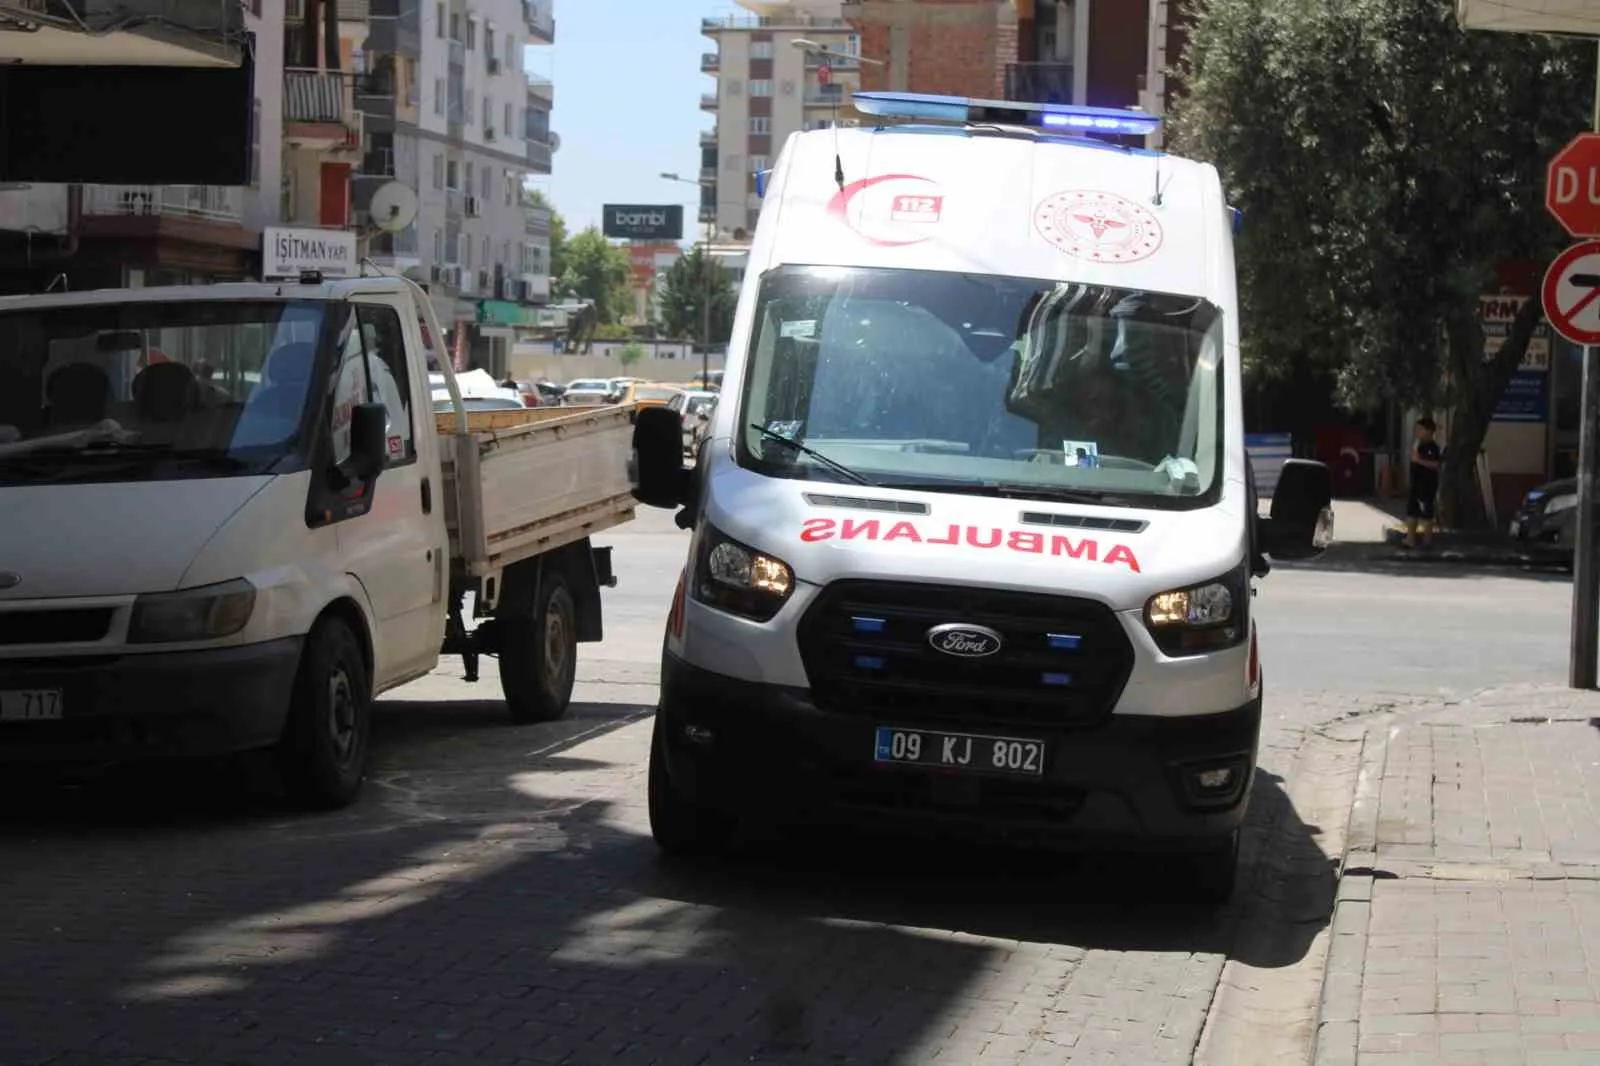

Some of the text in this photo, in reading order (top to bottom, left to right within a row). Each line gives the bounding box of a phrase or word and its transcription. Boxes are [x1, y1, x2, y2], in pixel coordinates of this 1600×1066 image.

[615, 210, 666, 226] bambi
[275, 232, 326, 263] İŞİTMAN
[943, 631, 988, 653] Ford
[21, 692, 59, 717] 717
[891, 732, 1038, 771] 09 KJ 802
